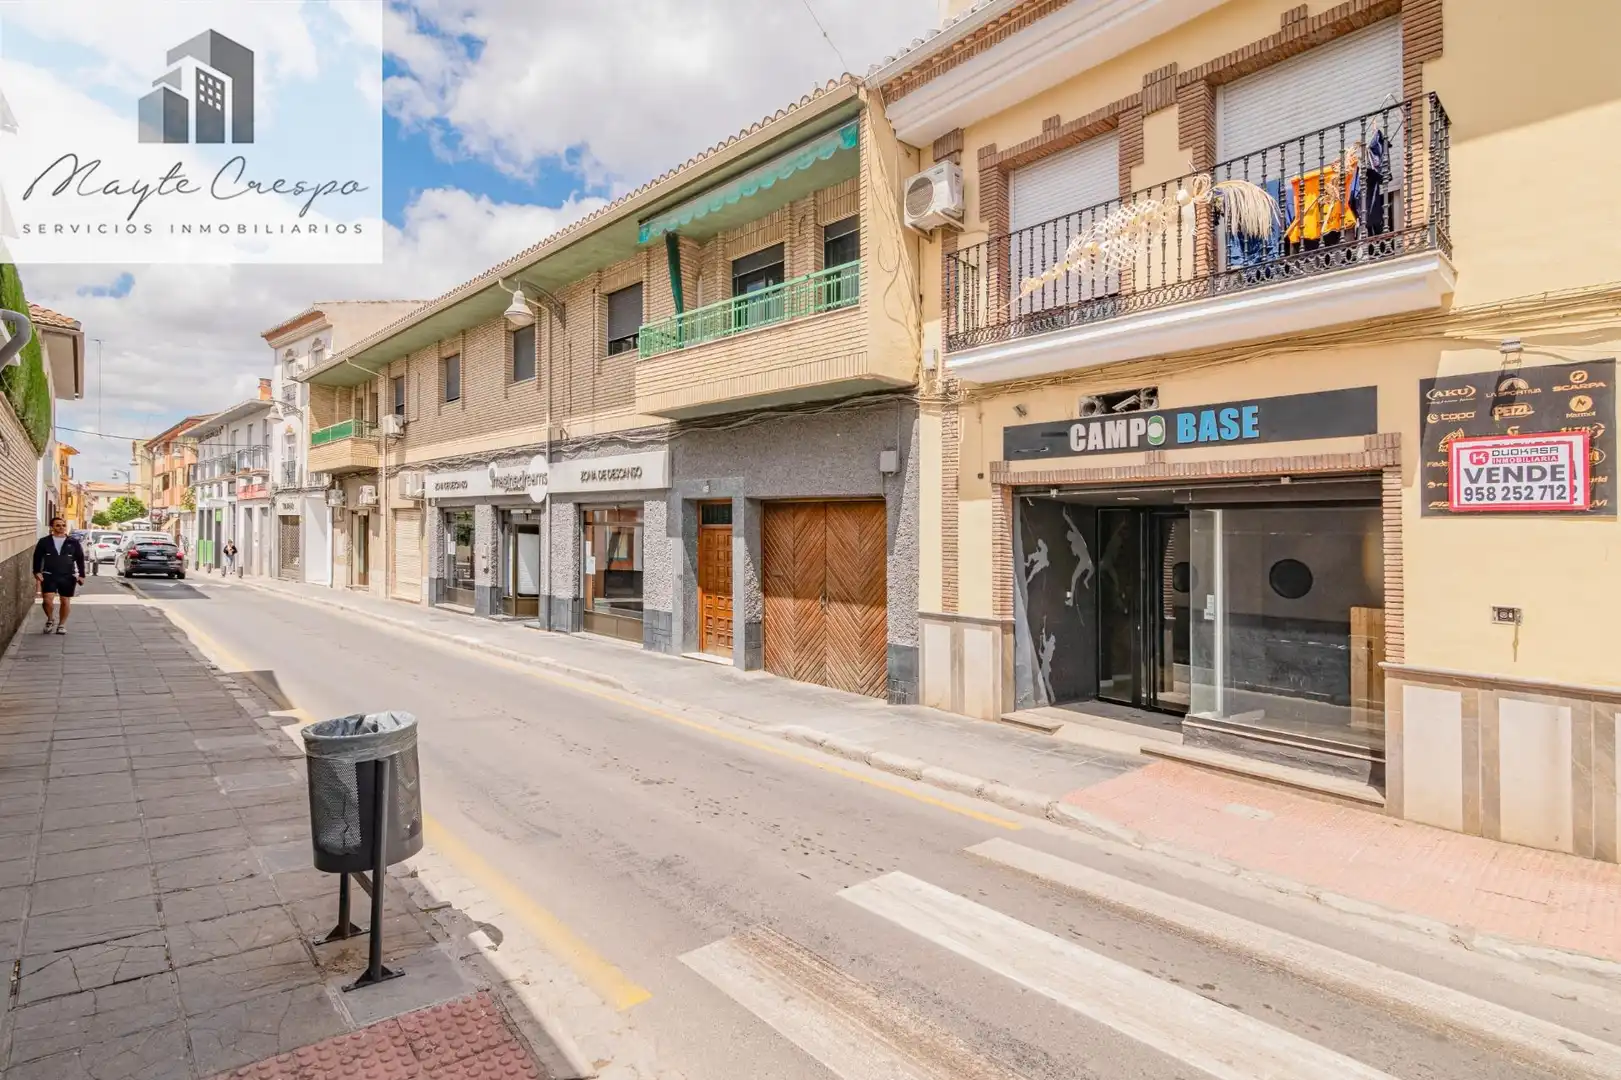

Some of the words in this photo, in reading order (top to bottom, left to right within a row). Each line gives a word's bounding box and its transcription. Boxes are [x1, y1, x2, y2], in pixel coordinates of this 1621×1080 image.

[1069, 414, 1167, 453] CAMPO
[1176, 405, 1260, 443] BASE
[1492, 447, 1559, 456] DUOKASA
[1492, 455, 1559, 464] INMOBILIARIA
[1464, 464, 1566, 484] VENDE
[1464, 487, 1497, 502] 958
[1501, 486, 1534, 501] 252
[1539, 485, 1567, 500] 712
